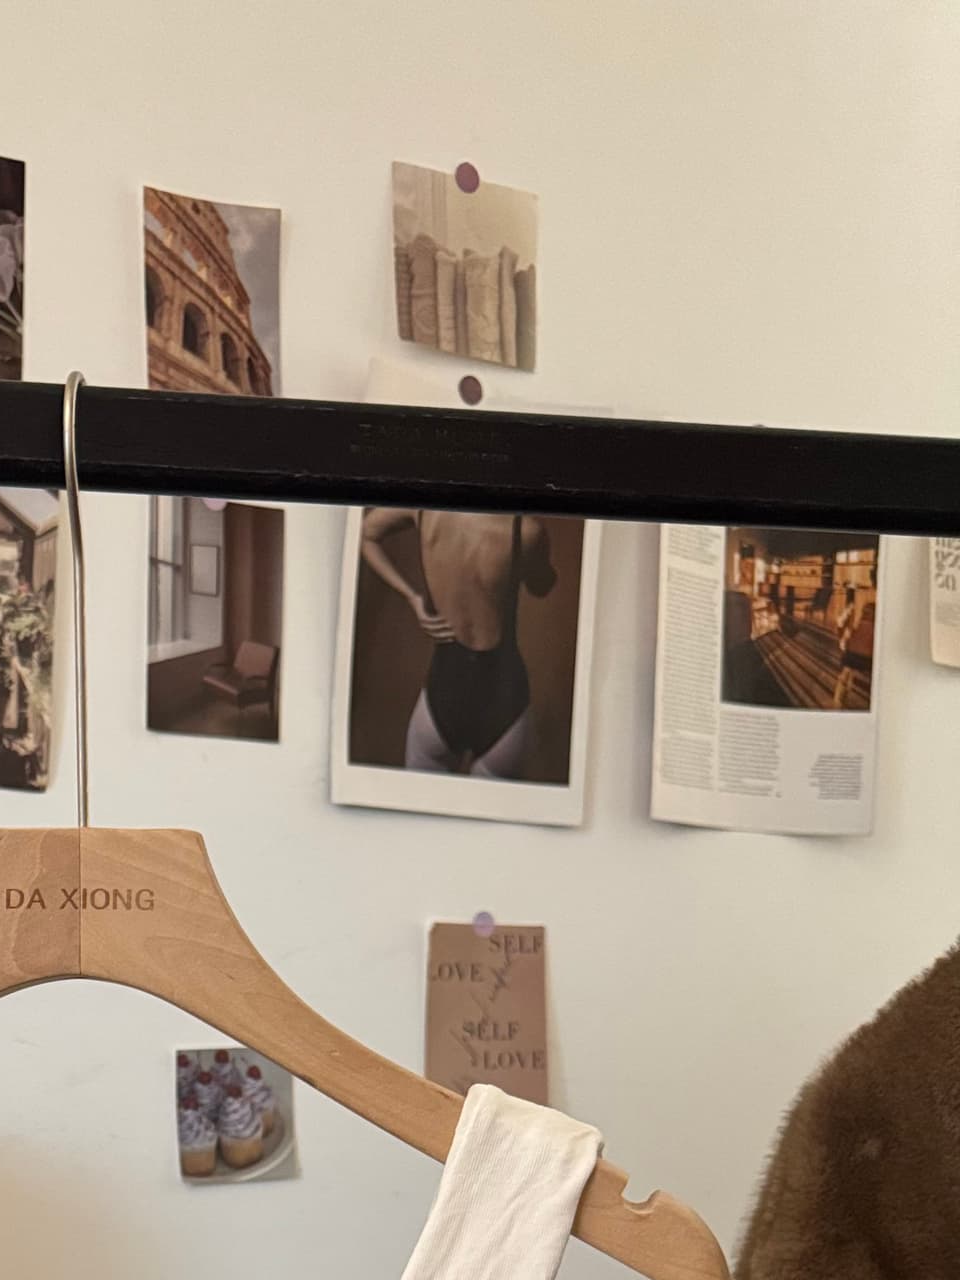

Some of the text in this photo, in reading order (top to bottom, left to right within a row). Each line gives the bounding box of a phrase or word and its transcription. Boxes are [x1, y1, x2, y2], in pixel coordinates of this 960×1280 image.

[6, 888, 155, 911] DA XIONG
[488, 935, 544, 954] SELF
[431, 962, 484, 983] OVE
[462, 1021, 519, 1041] SELF
[483, 1051, 545, 1071] LOVE
